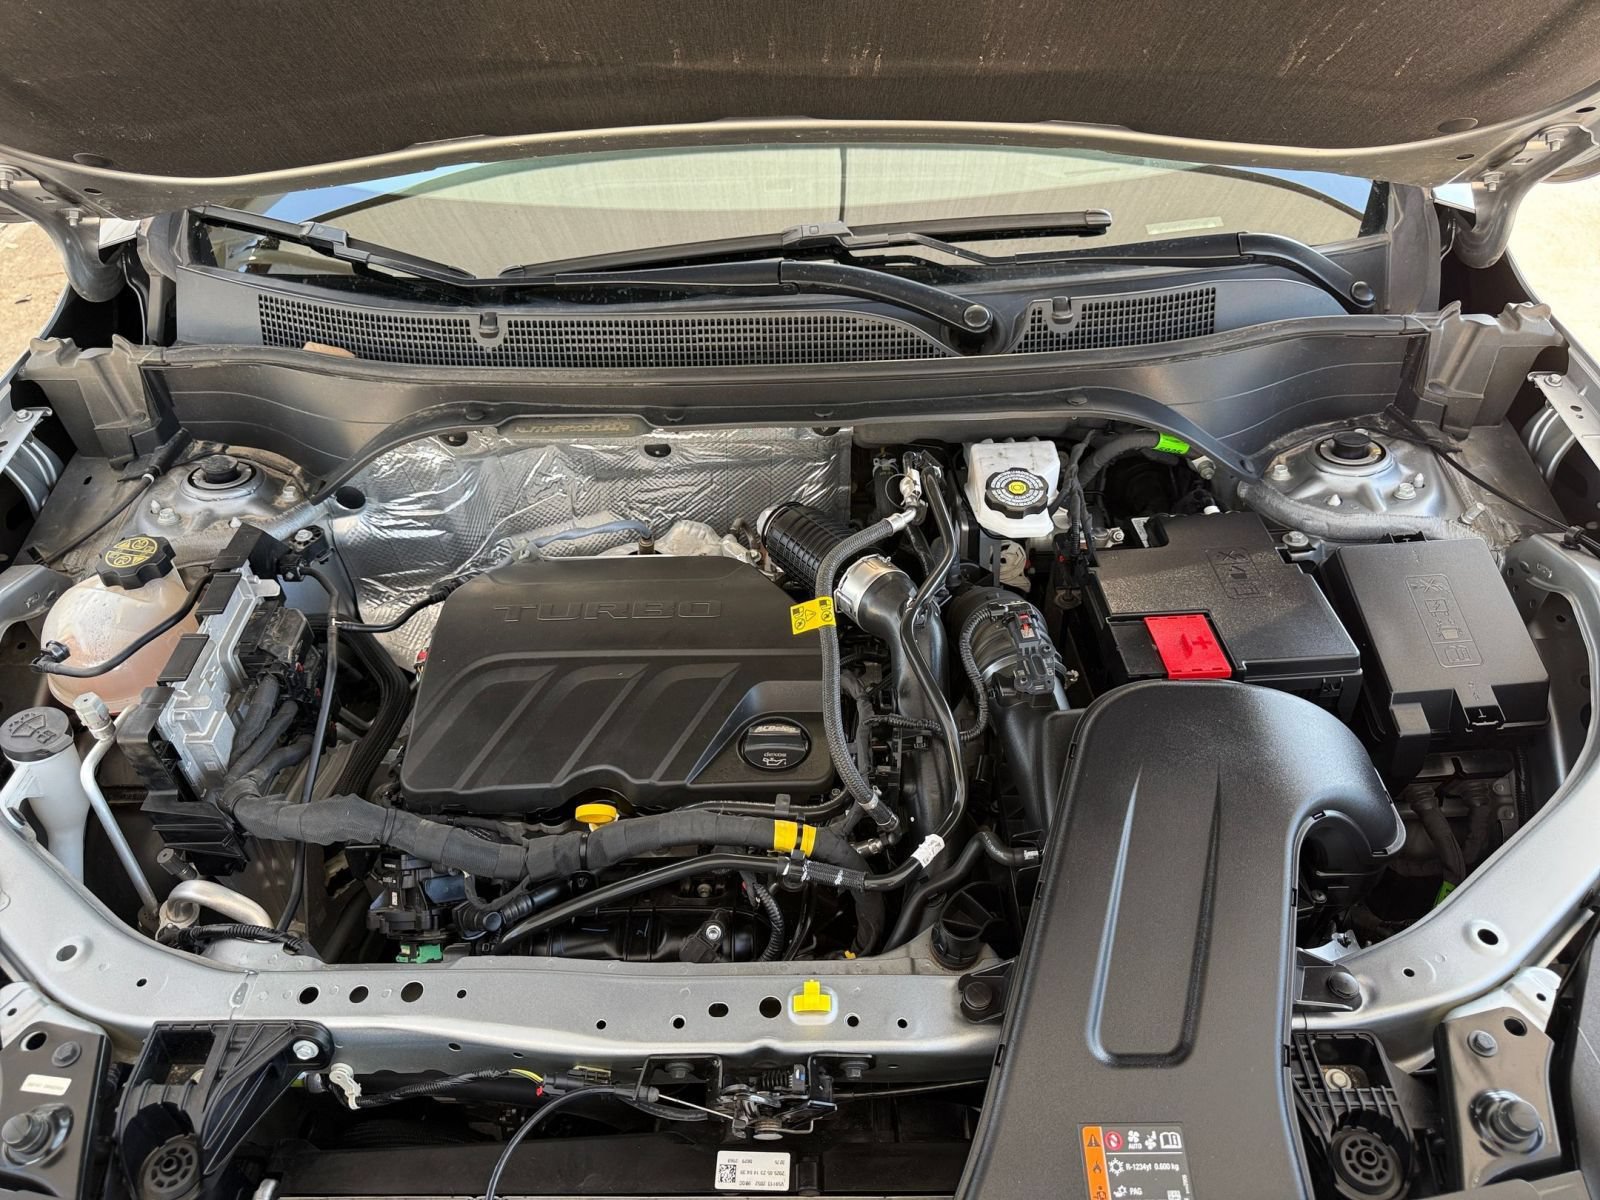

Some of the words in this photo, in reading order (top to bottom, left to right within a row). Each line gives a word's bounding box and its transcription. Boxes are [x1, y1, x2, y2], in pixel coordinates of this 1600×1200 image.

[494, 600, 722, 622] TURBO
[755, 725, 796, 733] ACDelco
[1125, 1162, 1152, 1172] R-1234yf
[1171, 1162, 1180, 1172] kg
[1129, 1187, 1143, 1195] PAG
